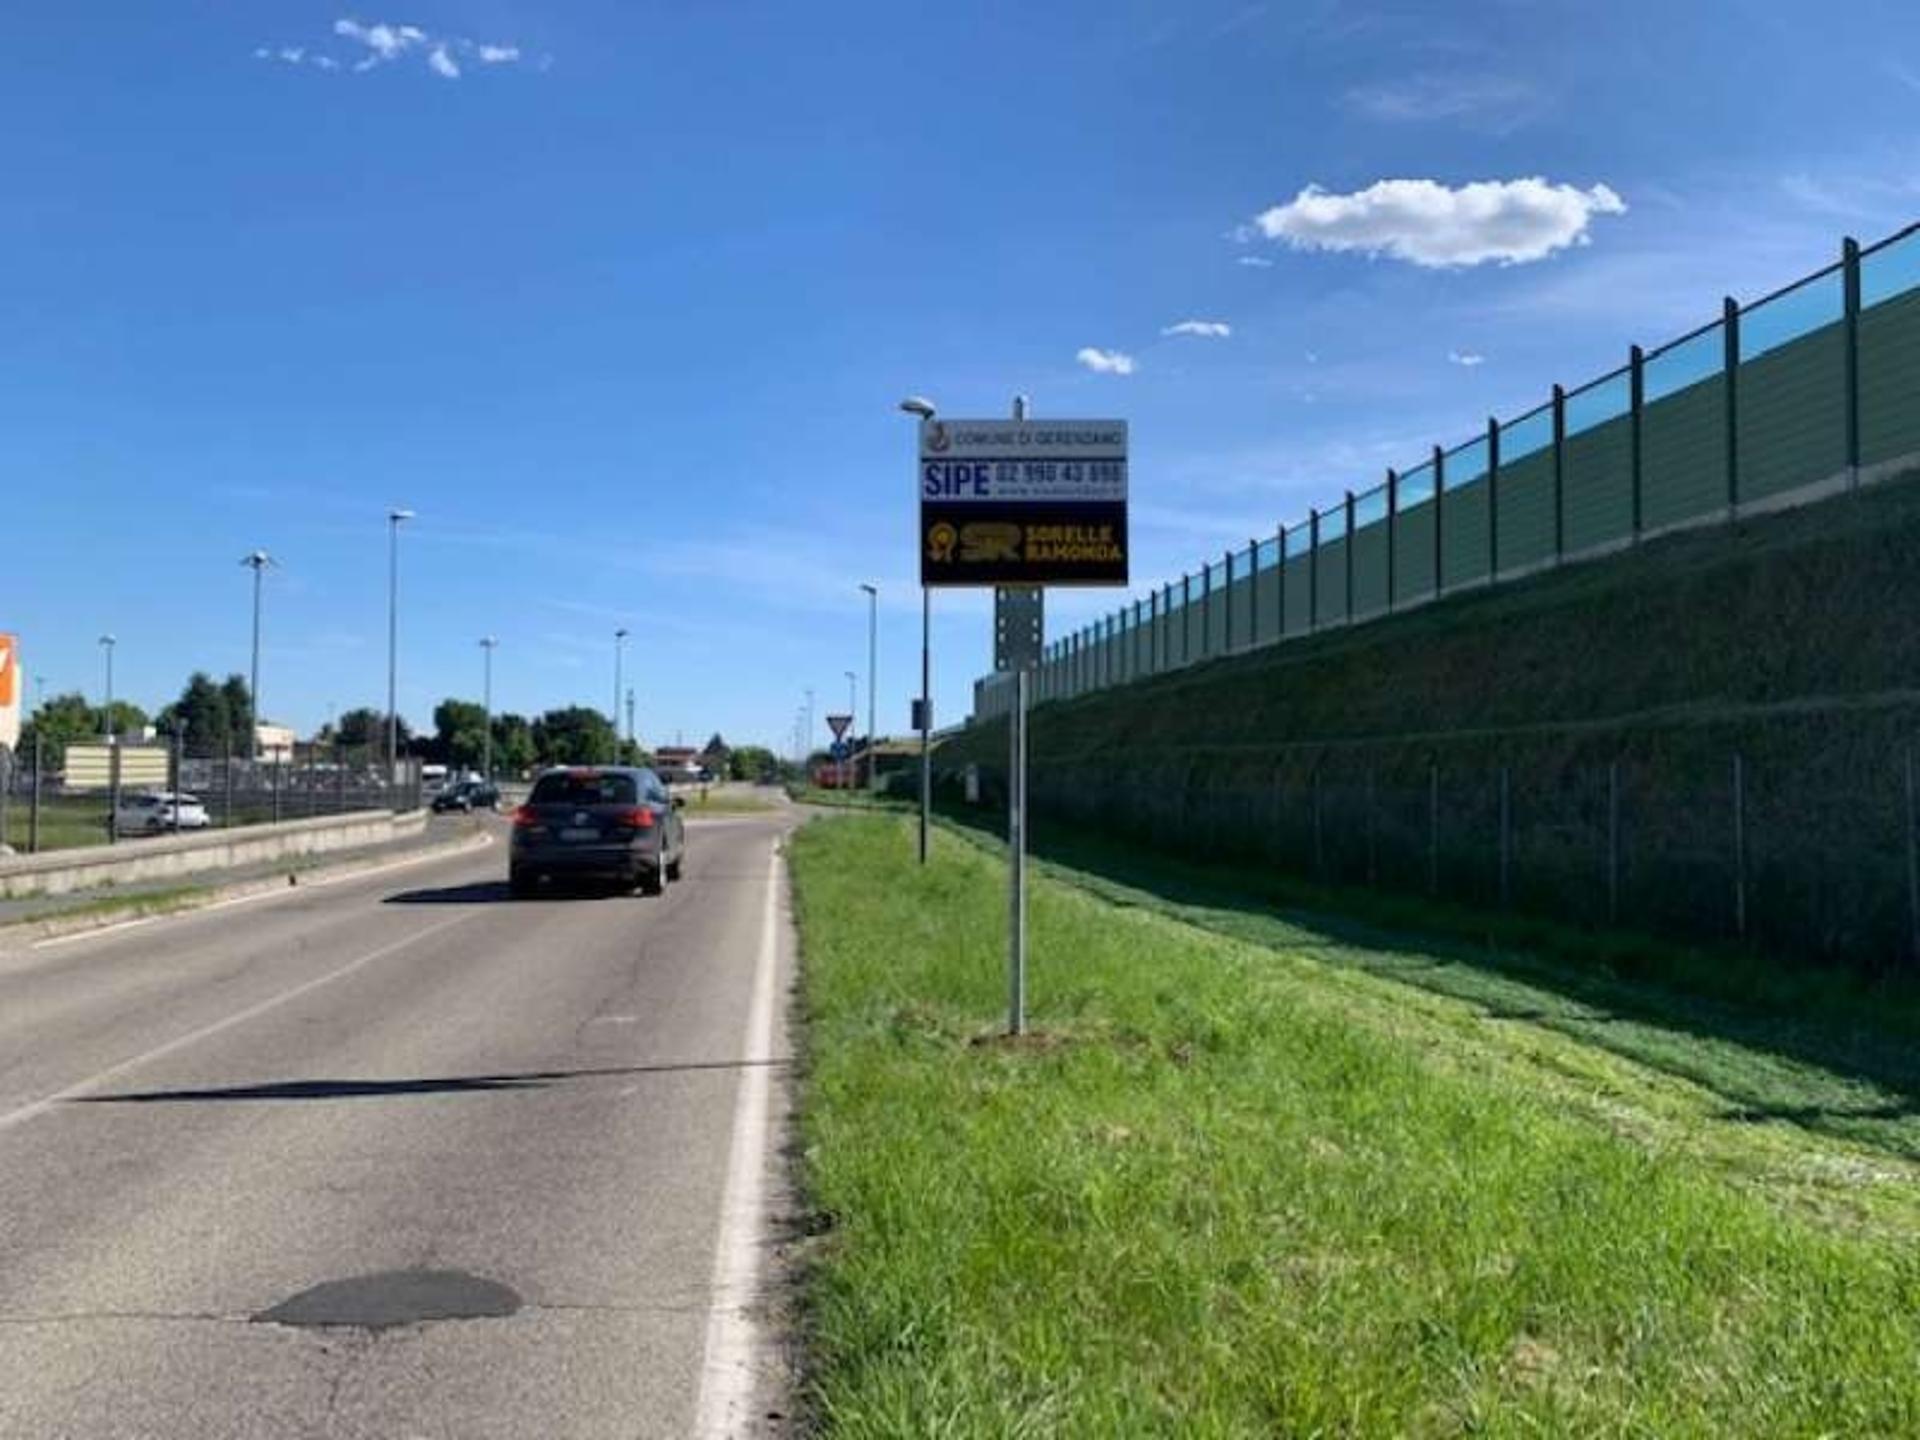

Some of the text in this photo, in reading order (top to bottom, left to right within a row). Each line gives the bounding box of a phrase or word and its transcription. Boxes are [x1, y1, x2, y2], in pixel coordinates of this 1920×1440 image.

[924, 464, 990, 496] SIPE
[1025, 525, 1113, 541] SORELLE
[1025, 543, 1123, 561] RAMONDA
